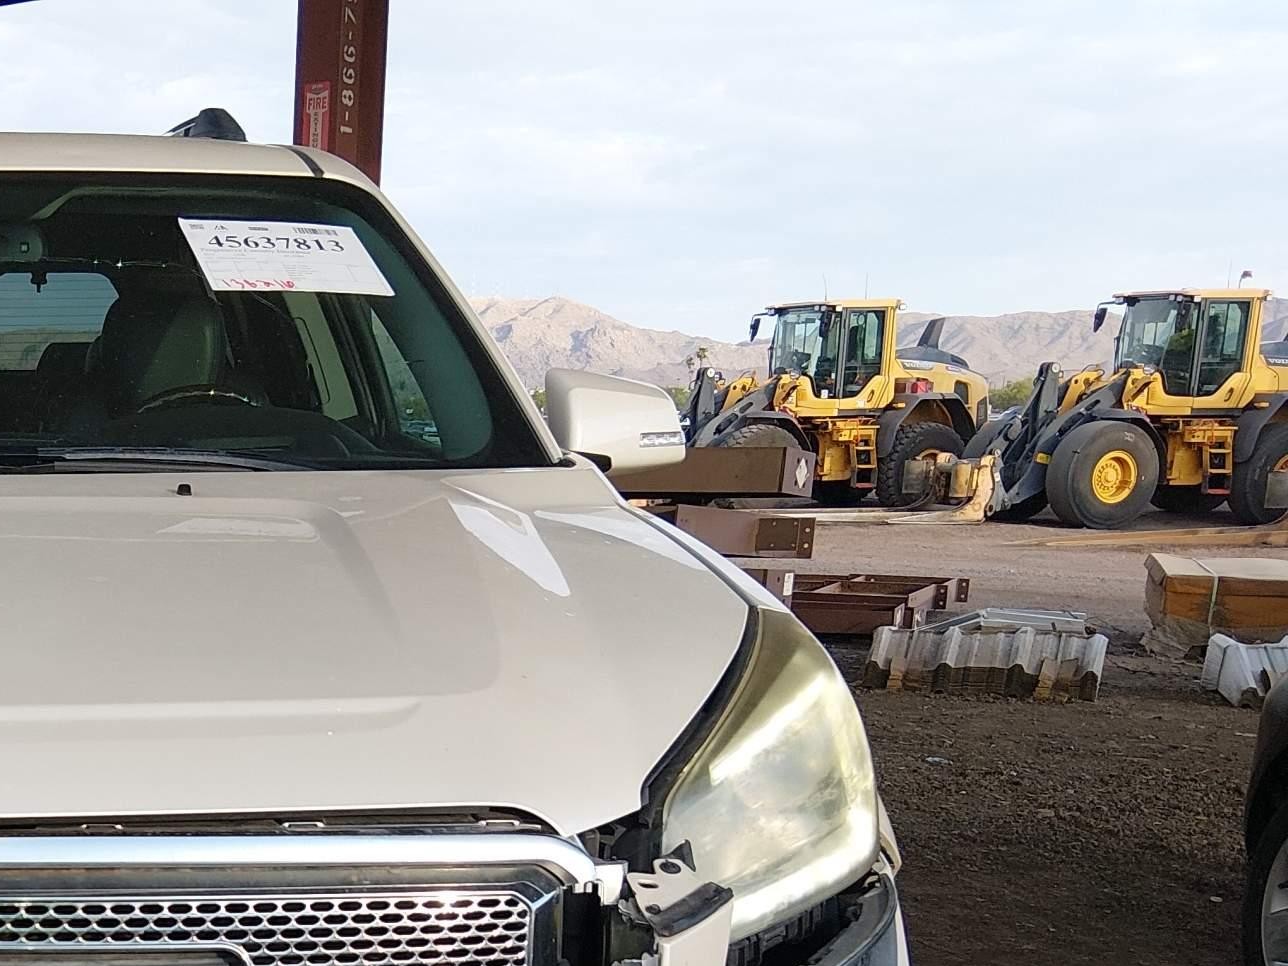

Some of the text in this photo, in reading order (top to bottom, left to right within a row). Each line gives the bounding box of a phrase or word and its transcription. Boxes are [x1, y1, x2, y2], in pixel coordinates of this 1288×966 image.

[339, 0, 357, 134] 1-866-7
[308, 96, 327, 110] FIRE
[208, 235, 345, 252] 45637813
